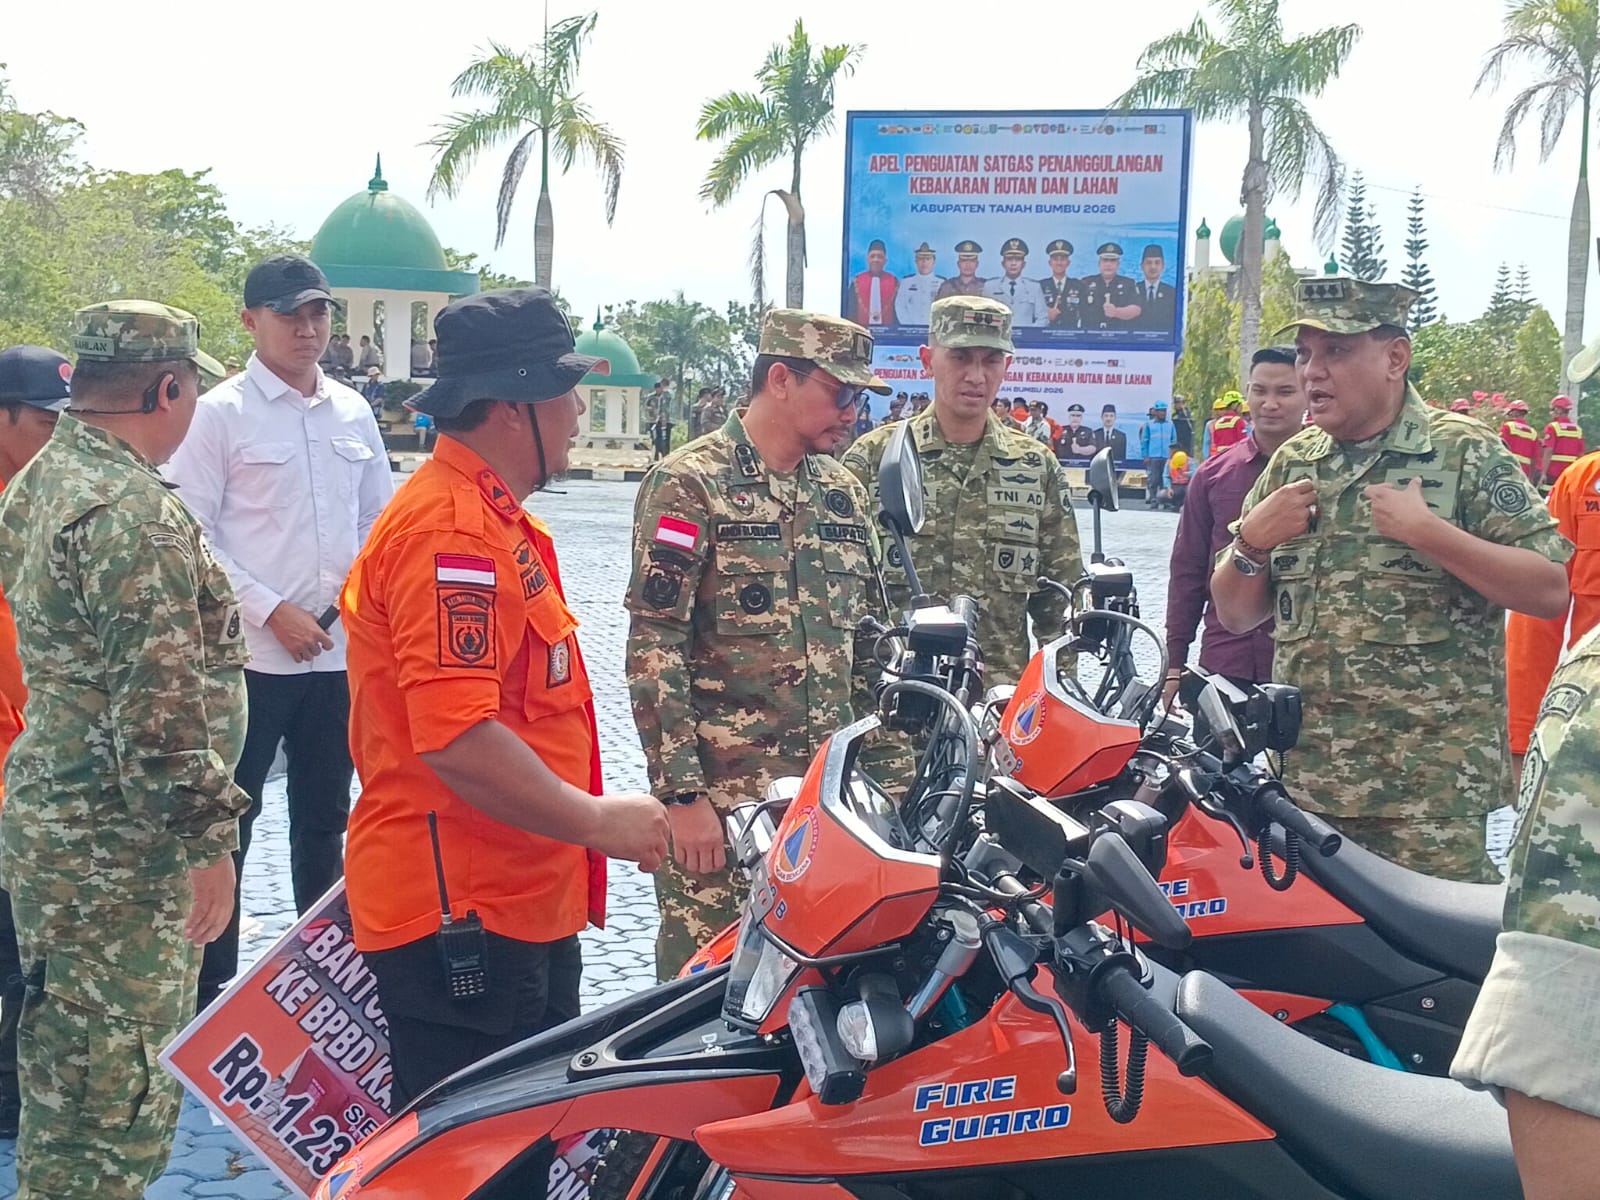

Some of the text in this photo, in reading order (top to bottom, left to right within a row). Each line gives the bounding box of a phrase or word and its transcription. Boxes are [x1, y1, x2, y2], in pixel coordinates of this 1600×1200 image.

[869, 154, 1163, 173] APEL PENGUATAN SATGAS PENANGGULANGAN
[909, 176, 1119, 195] KEBAKARAN HUTAN DAN LAHAN
[910, 203, 1116, 214] KABUPATEN TANAH BUMBU 2026
[1025, 371, 1075, 384] KEBAKARAN
[1077, 372, 1104, 384] HUTAN
[1105, 373, 1123, 385] DAN
[1124, 373, 1153, 386] LAHAN
[994, 490, 1043, 506] TNI AD
[264, 960, 322, 1017] KE
[298, 993, 377, 1073] BPBD
[913, 1076, 1017, 1112] FIRE
[919, 1104, 1071, 1146] GUARD
